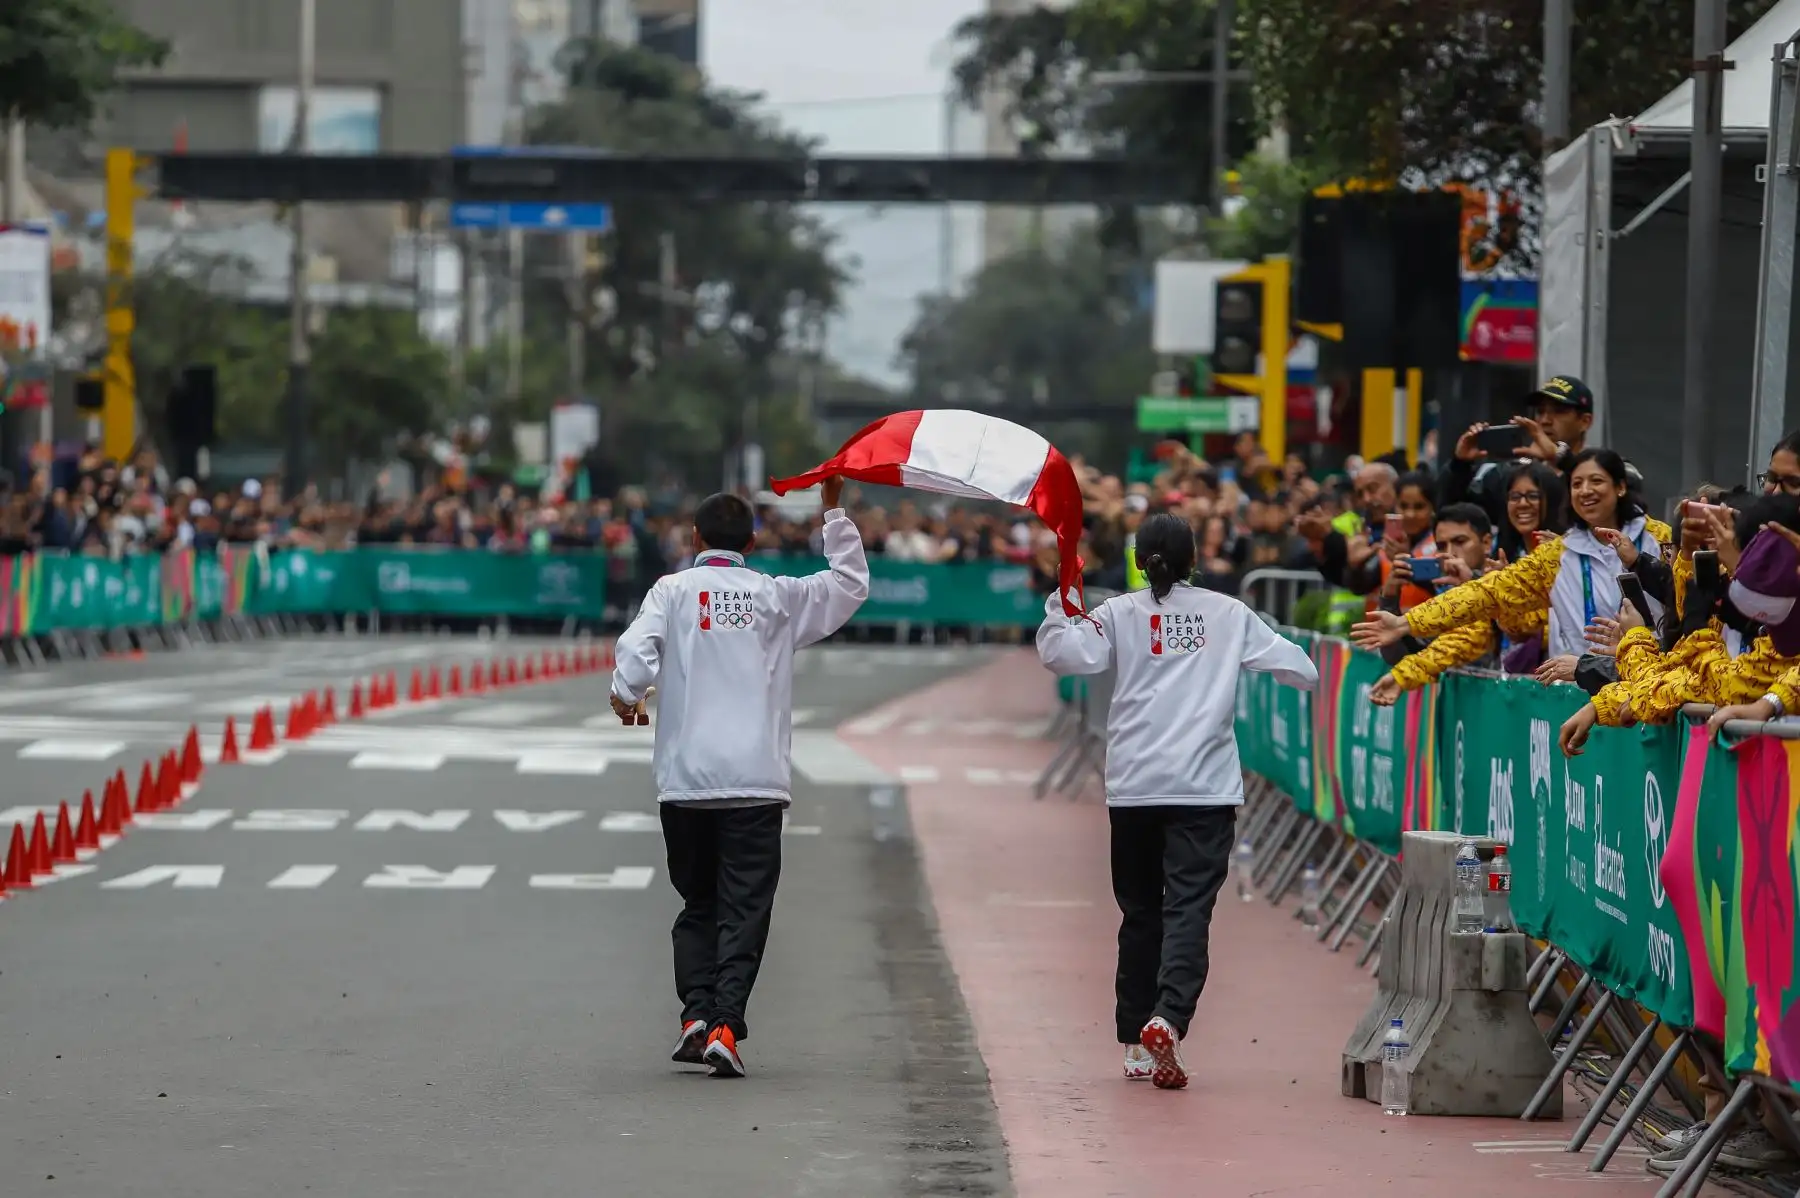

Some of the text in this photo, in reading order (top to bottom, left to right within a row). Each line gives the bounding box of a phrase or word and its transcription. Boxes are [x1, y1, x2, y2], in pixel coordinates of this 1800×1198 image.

[713, 591, 752, 601] TEAM
[715, 601, 753, 613] PERÚ
[1164, 614, 1204, 624] TEAM
[1166, 623, 1205, 636] PERÚ
